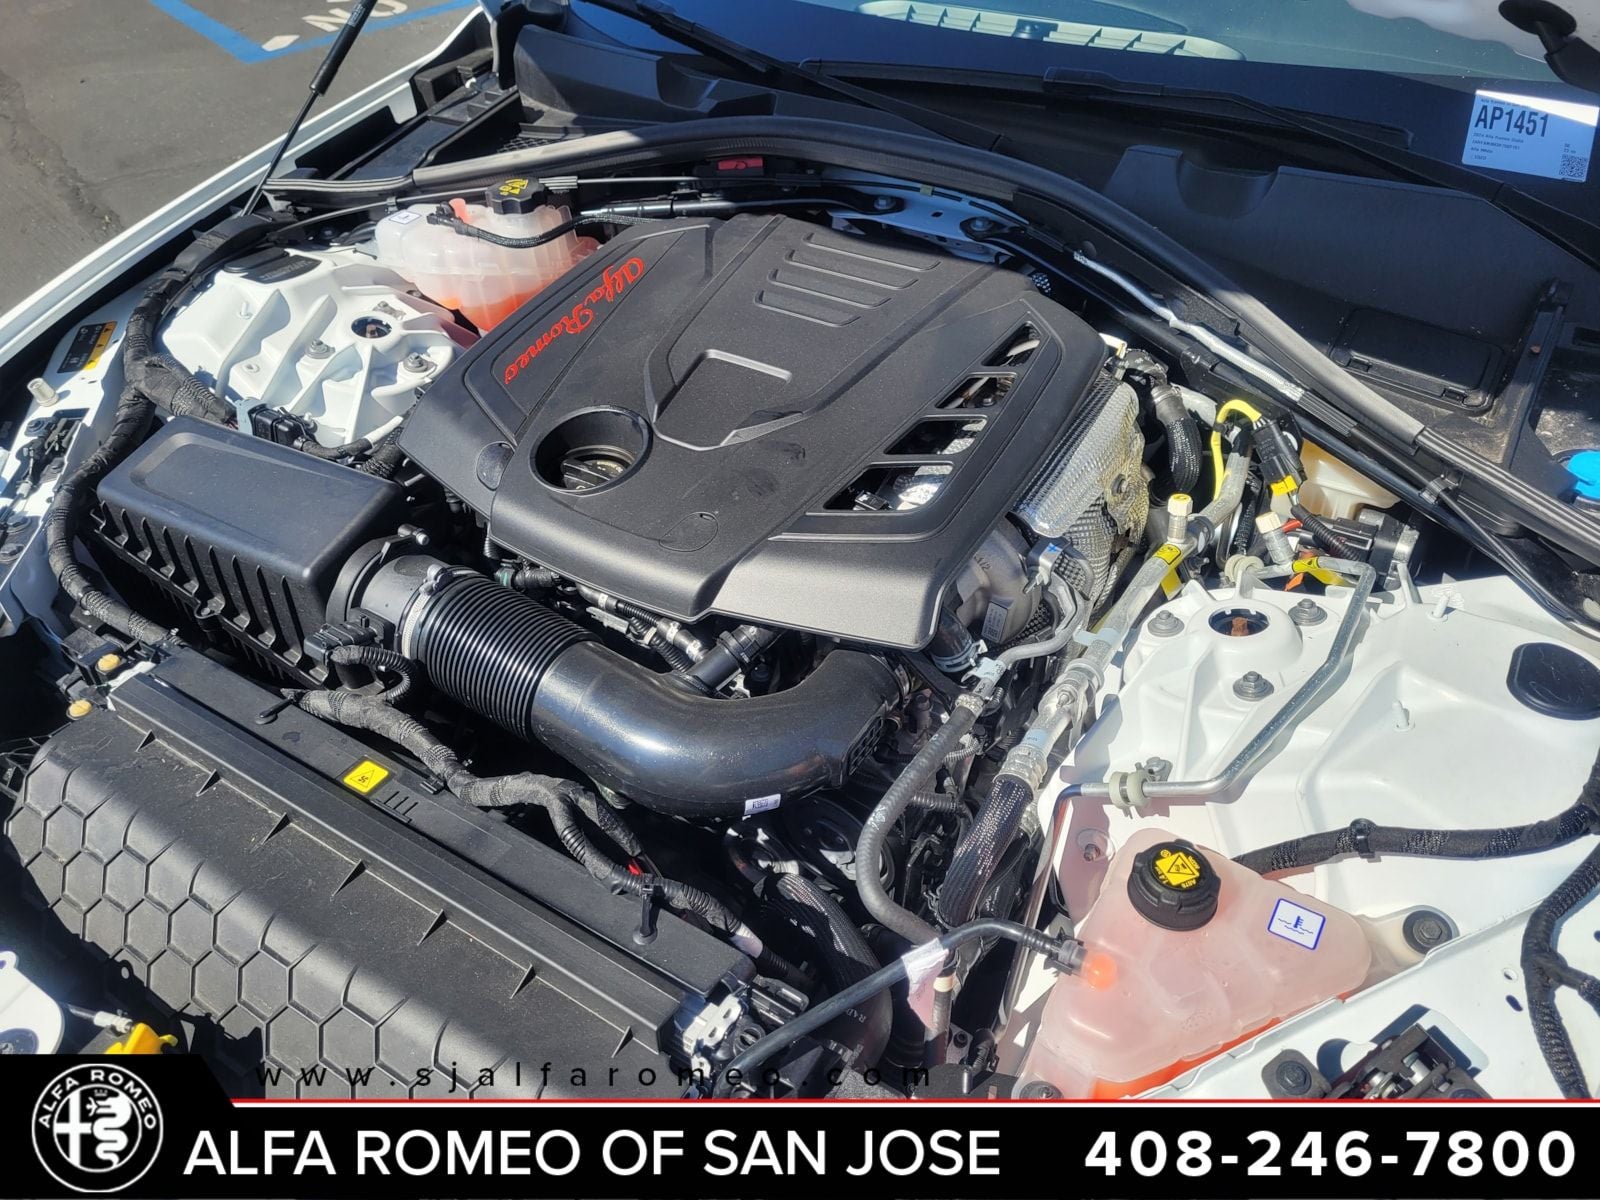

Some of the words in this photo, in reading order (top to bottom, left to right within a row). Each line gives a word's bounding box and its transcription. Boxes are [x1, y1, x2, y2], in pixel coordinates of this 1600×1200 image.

[1474, 104, 1549, 138] AP1451
[585, 257, 645, 304] Alfa
[504, 303, 594, 385] Romeo
